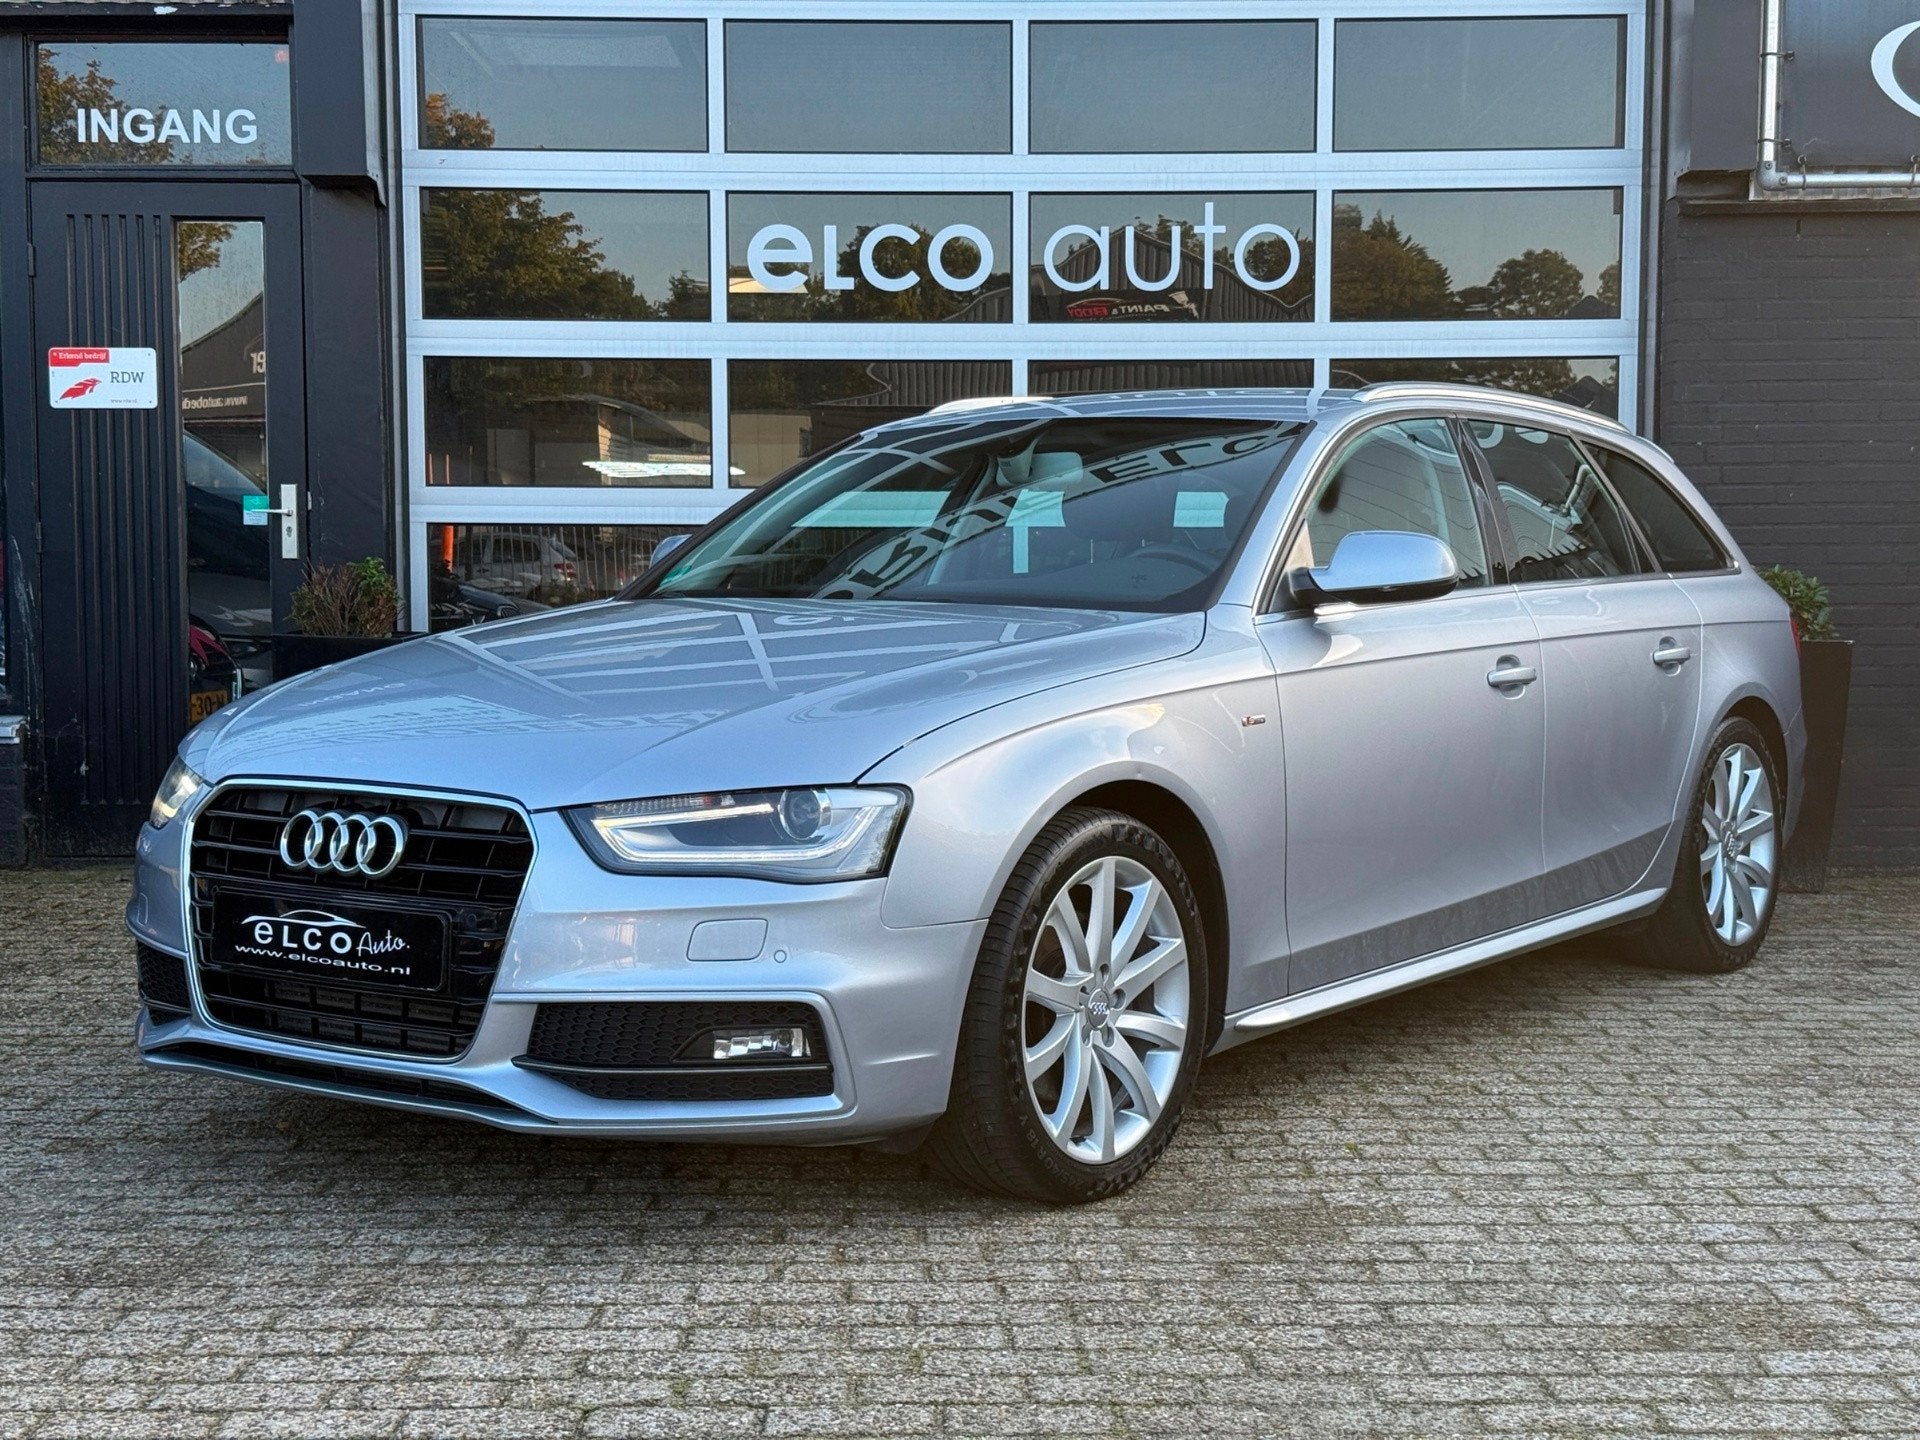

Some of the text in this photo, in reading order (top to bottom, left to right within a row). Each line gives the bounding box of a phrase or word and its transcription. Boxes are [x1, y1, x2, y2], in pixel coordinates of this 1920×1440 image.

[77, 108, 258, 144] INGANG
[1044, 202, 1301, 292] auto
[110, 371, 145, 383] RDW
[235, 945, 410, 976] www.elcoauto.nl
